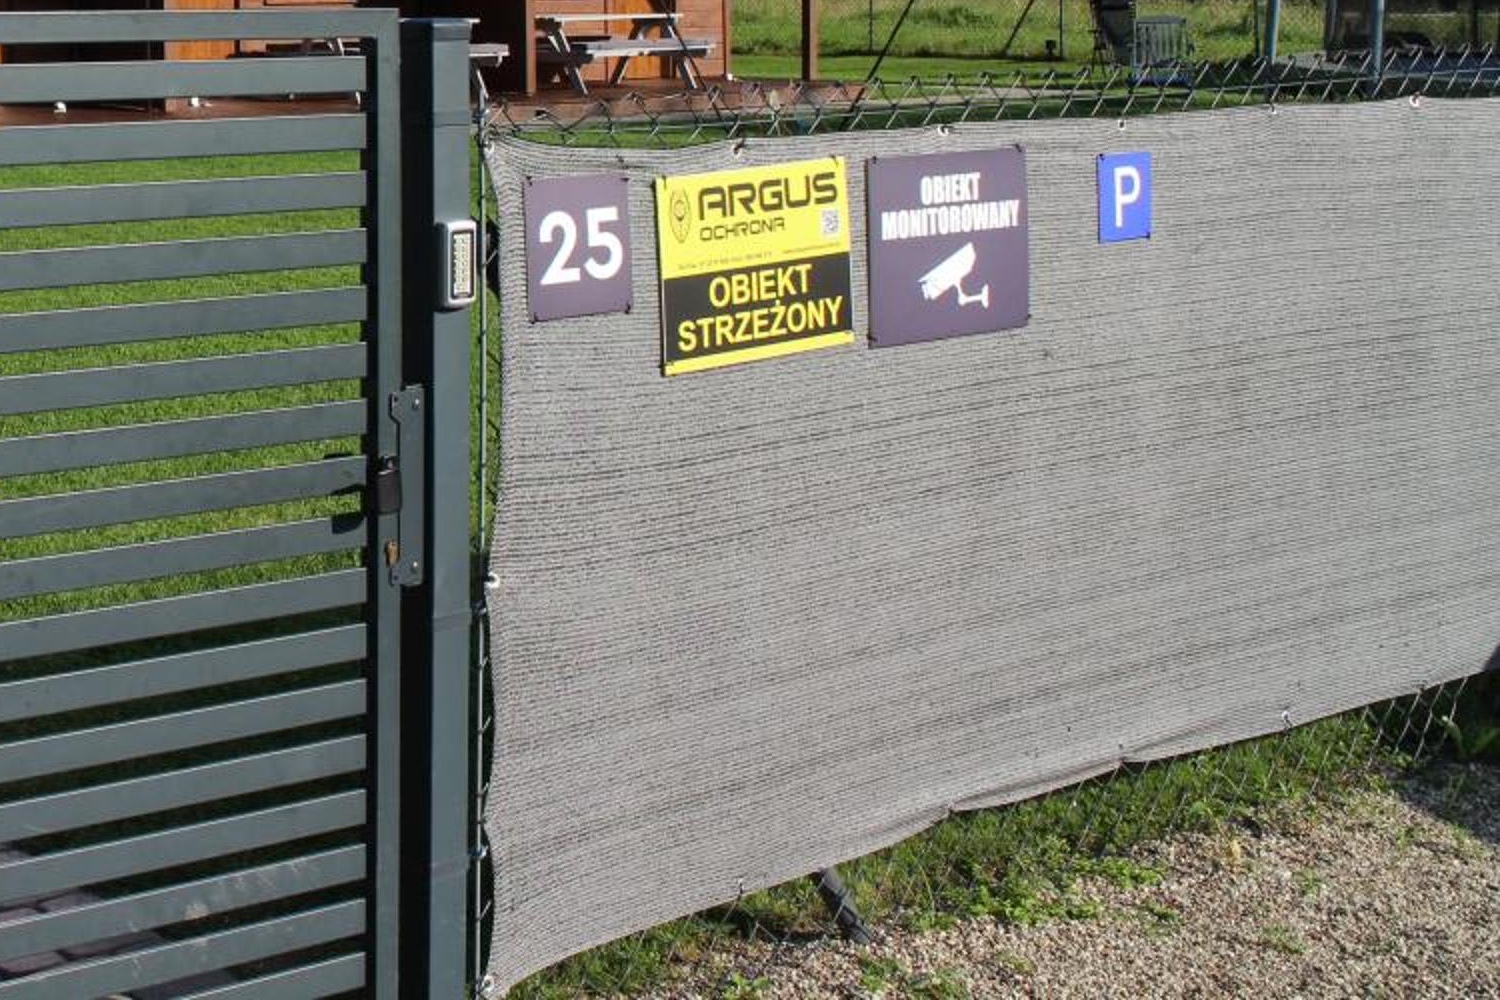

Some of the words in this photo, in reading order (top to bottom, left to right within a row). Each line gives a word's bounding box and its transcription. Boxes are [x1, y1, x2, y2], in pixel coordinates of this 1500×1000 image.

[698, 171, 838, 221] ARGUS
[920, 171, 981, 206] OBIEKT
[1113, 165, 1141, 228] P
[700, 217, 785, 242] OCHRONA
[881, 199, 1020, 241] MONITOROWANY
[539, 206, 623, 285] 25
[709, 263, 812, 308] OBIEKT
[677, 295, 843, 352] STRZEŻONY
